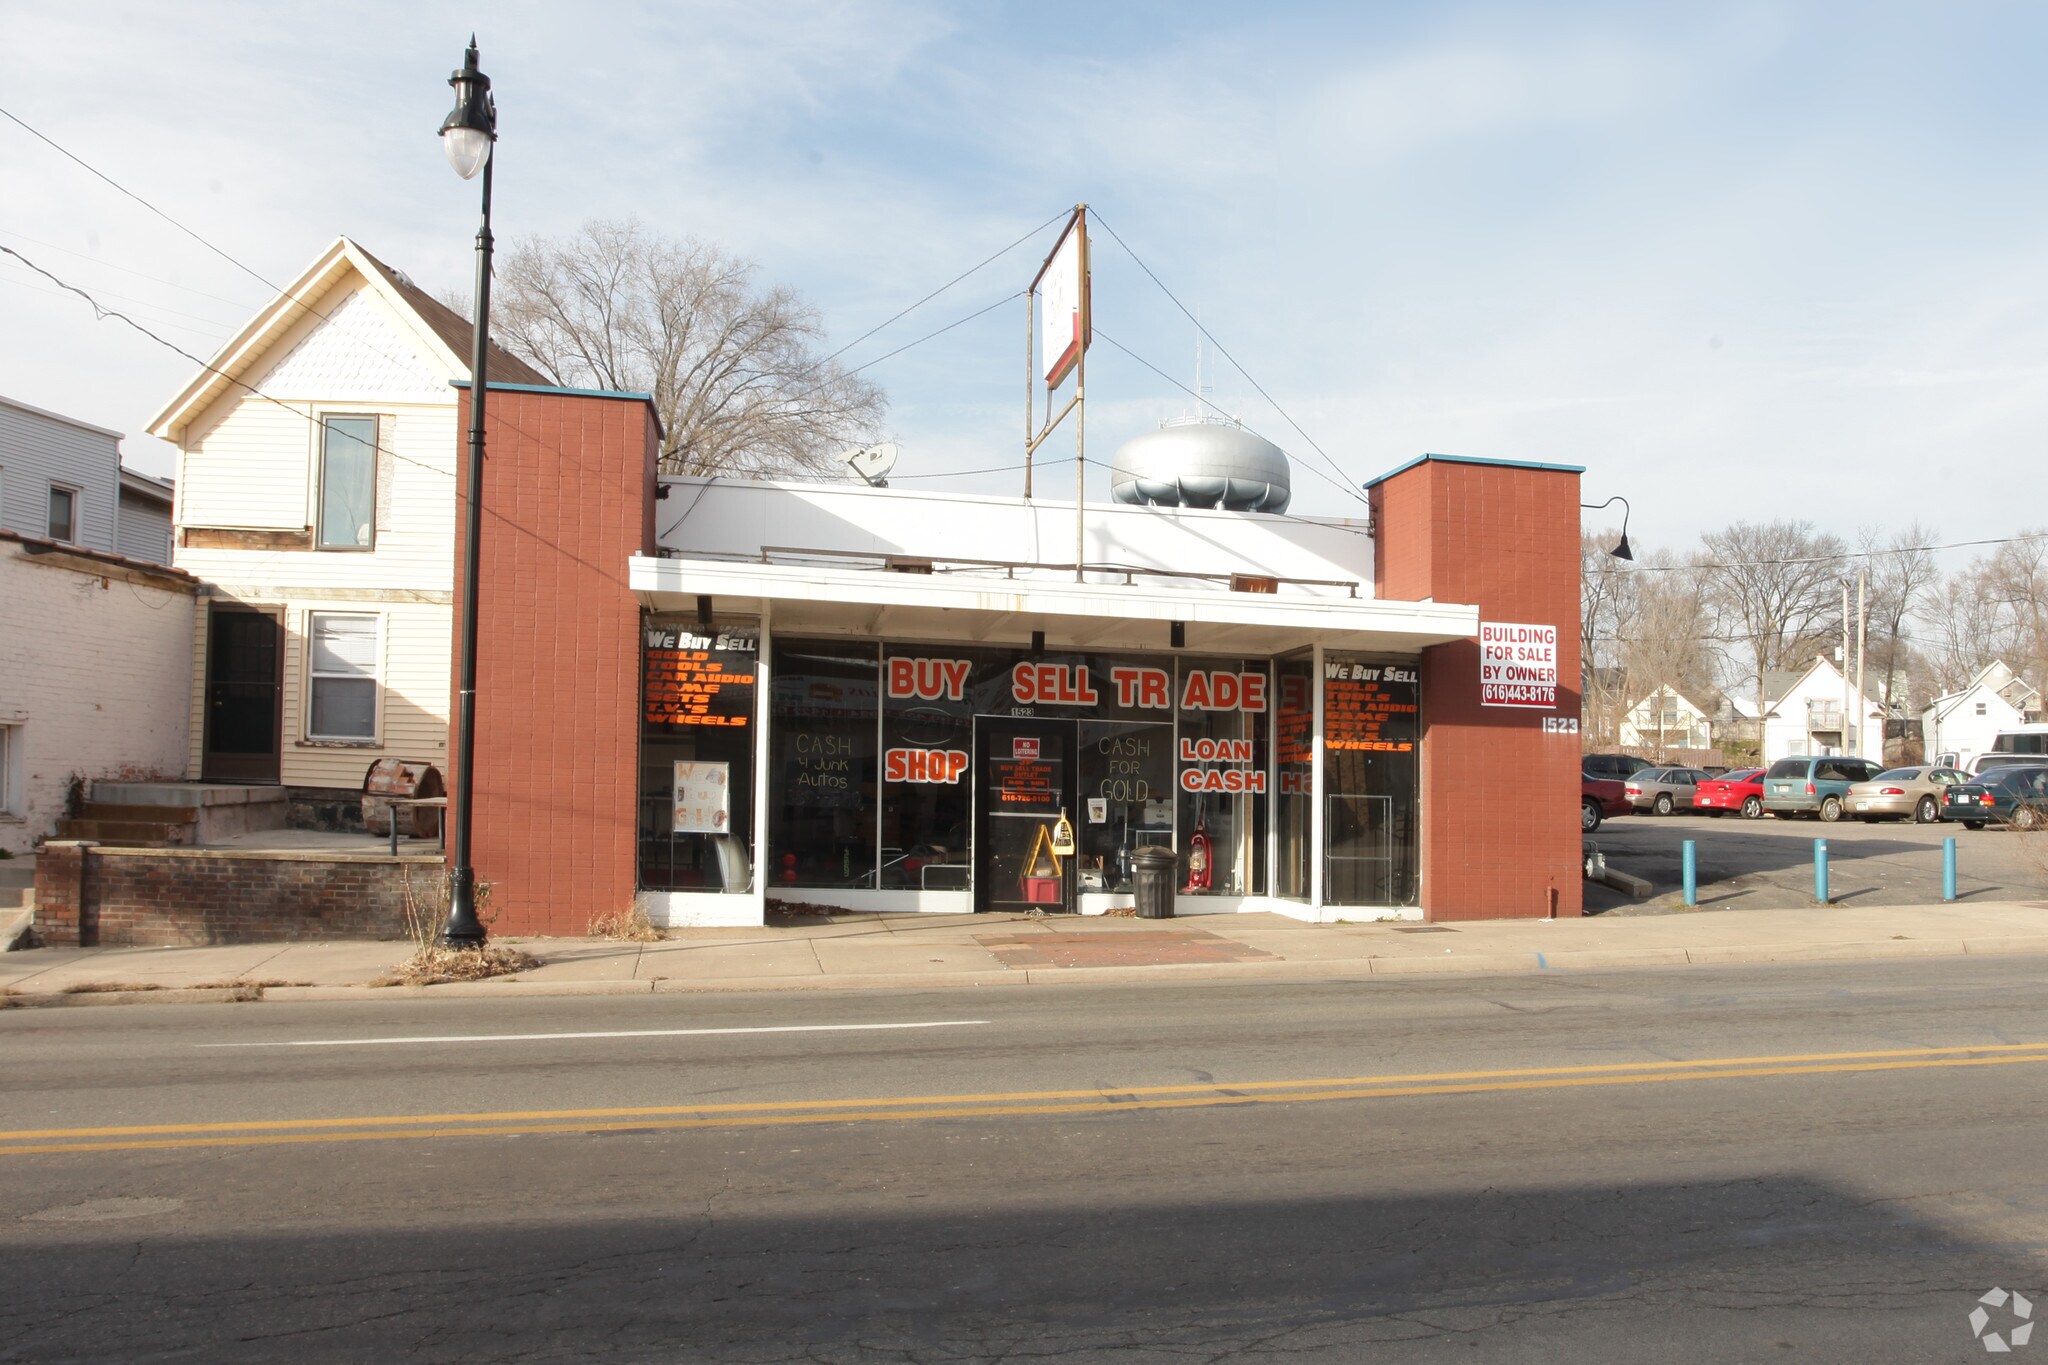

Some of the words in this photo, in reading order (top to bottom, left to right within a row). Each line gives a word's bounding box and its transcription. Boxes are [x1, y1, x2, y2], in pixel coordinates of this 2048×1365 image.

[1482, 627, 1555, 645] BUILDING
[647, 651, 709, 661] GOLD
[1486, 646, 1513, 661] FOR
[1517, 647, 1552, 662] SALE
[647, 661, 723, 672] TOOLS
[647, 671, 689, 682] CAR
[692, 673, 754, 685] AUDIO
[1483, 666, 1501, 680] BY
[1505, 666, 1555, 682] OWNER
[647, 682, 721, 694] GAME
[888, 657, 972, 701] BUY
[1012, 661, 1097, 706] SELL
[1326, 681, 1379, 692] GOLD
[647, 692, 711, 704] SETS
[1326, 691, 1391, 702] TOOLS
[1482, 684, 1555, 704] (616)443-8176
[1012, 708, 1034, 718] 1523
[1326, 701, 1362, 712] CAR
[1364, 703, 1418, 713] AUDIO
[646, 714, 748, 727] WHEELS
[1325, 711, 1389, 723] GAME
[1326, 722, 1381, 732] SETS
[1542, 717, 1579, 734] 1523
[1098, 736, 1150, 757] CASH
[1180, 738, 1252, 763] LOAN
[1325, 740, 1413, 753] WHEELS
[798, 756, 808, 769] 4
[885, 748, 968, 784] SHOP
[1109, 760, 1141, 775] FOR
[1180, 767, 1266, 795] CASH
[1100, 778, 1149, 802] GOLD
